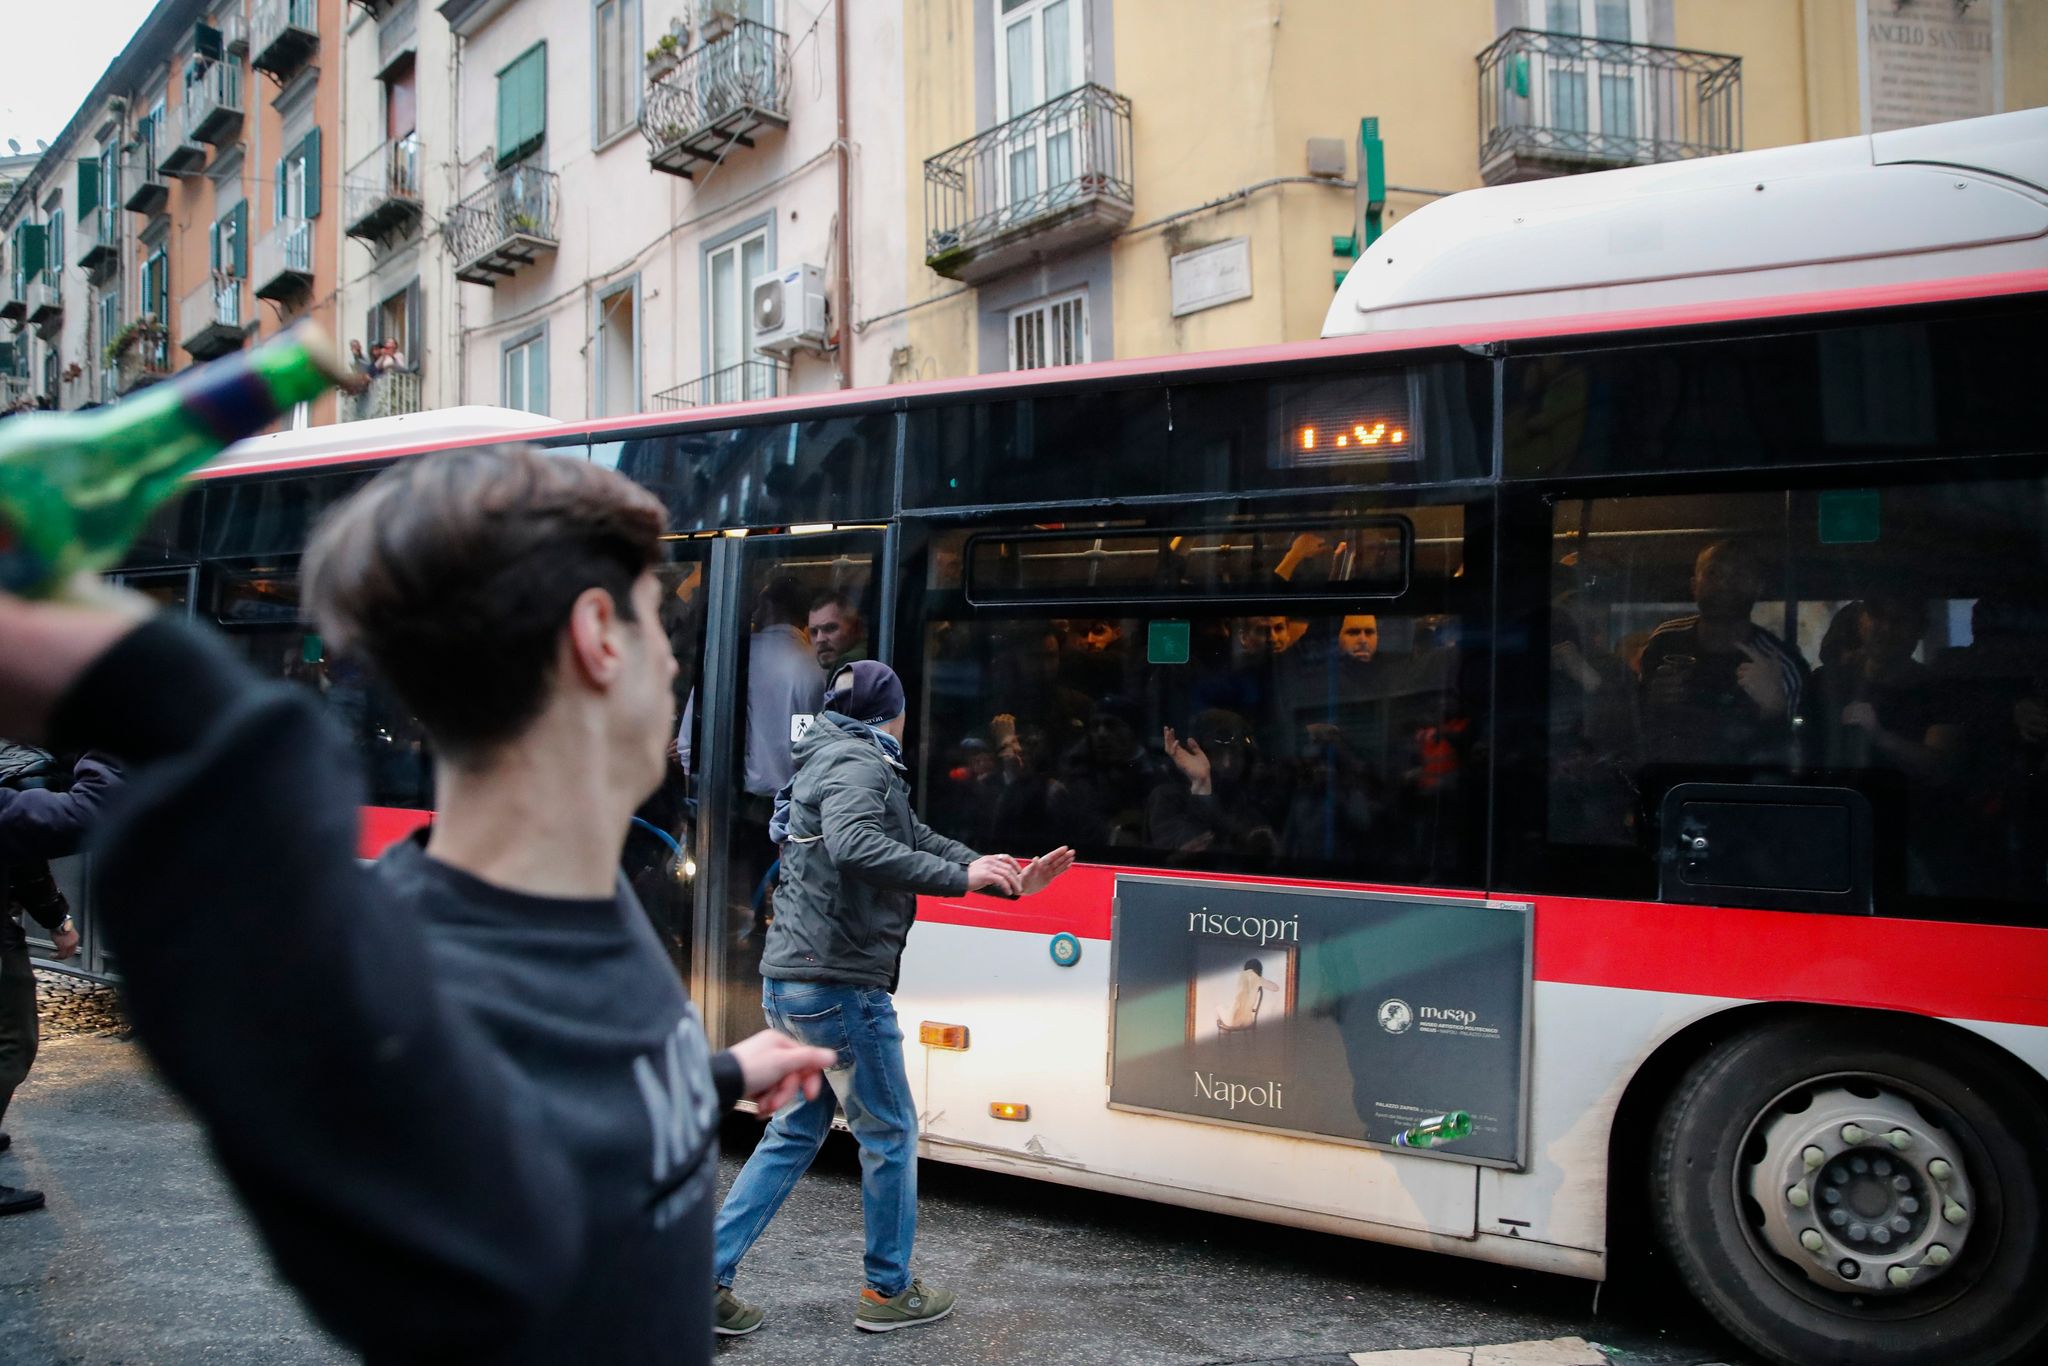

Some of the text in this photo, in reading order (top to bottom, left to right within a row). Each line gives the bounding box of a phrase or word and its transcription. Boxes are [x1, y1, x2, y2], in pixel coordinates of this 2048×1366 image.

[1188, 906, 1299, 947] riscopri
[1420, 1006, 1476, 1025] musap
[1194, 1071, 1283, 1110] Napoli
